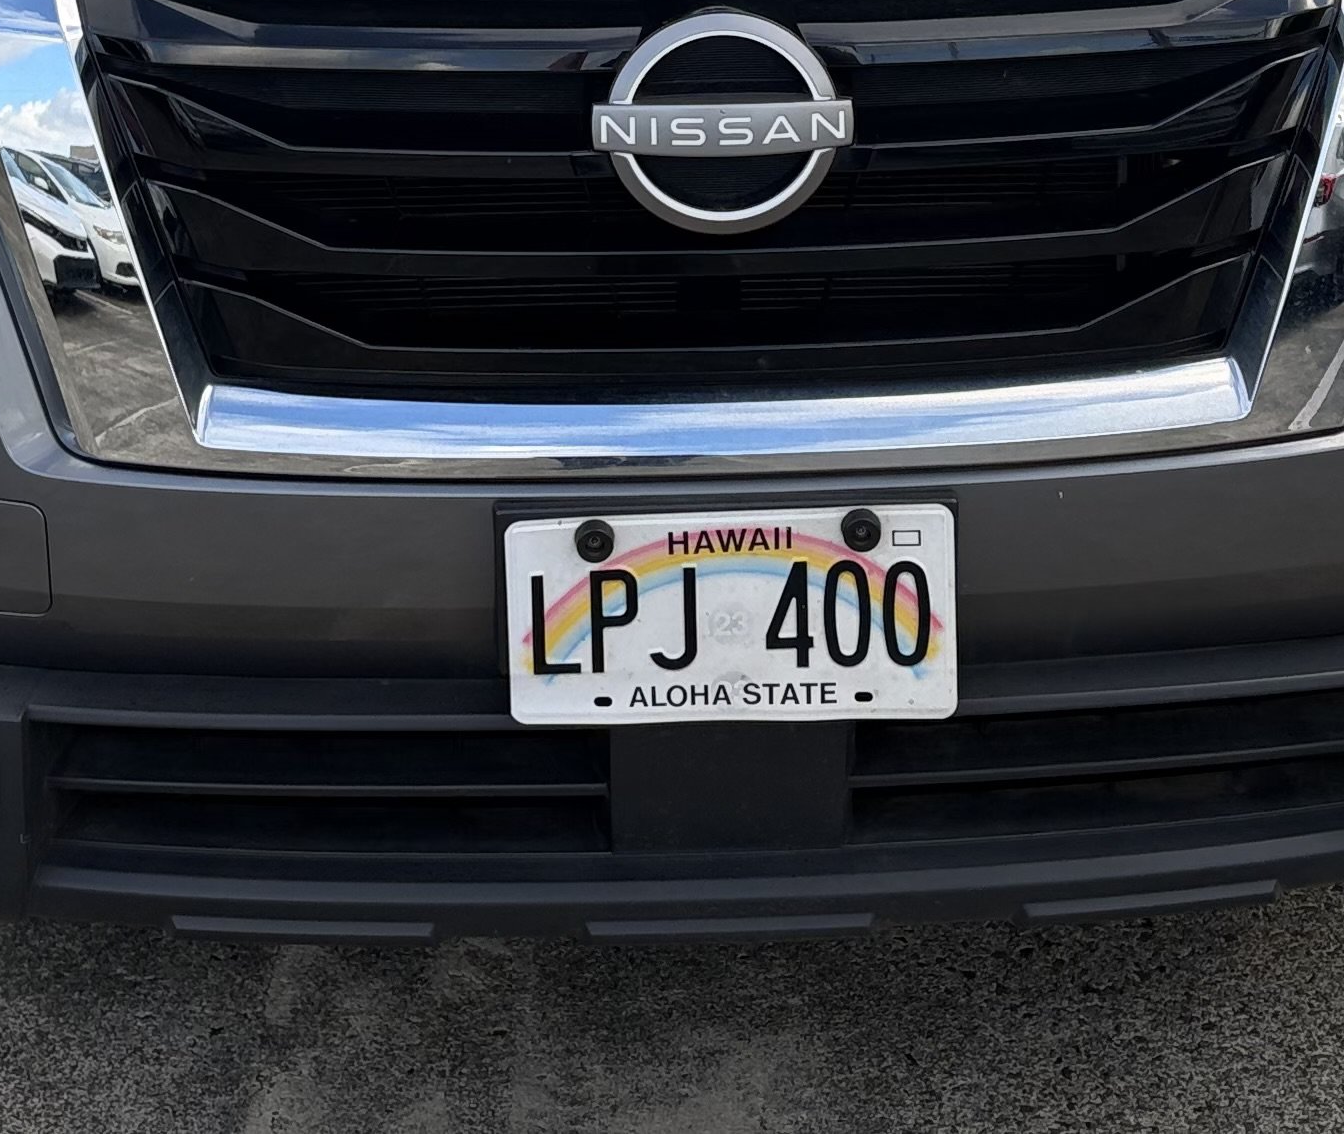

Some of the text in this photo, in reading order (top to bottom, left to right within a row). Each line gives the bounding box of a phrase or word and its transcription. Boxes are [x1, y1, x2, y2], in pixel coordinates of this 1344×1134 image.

[600, 110, 846, 146] NISSAN
[667, 526, 793, 556] HAWAII
[530, 559, 931, 676] LPJ 400
[628, 684, 732, 708] ALOHA
[742, 681, 838, 706] STATE
